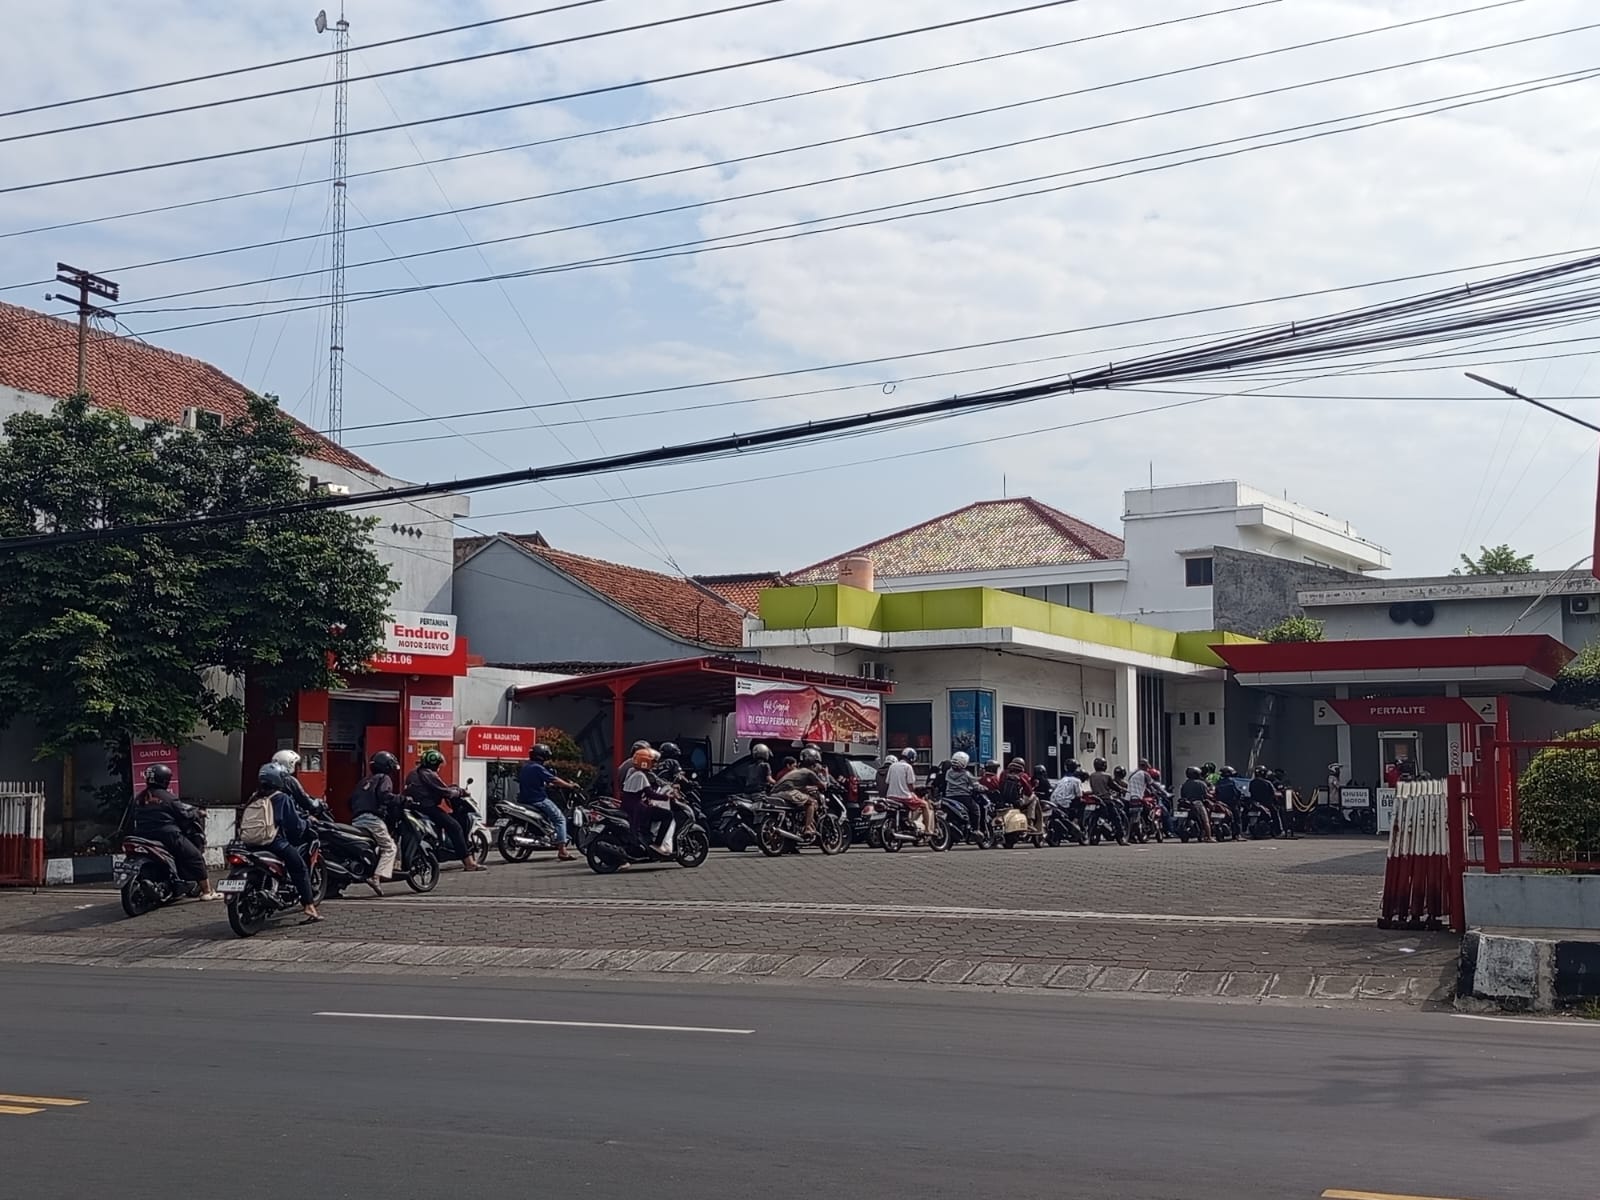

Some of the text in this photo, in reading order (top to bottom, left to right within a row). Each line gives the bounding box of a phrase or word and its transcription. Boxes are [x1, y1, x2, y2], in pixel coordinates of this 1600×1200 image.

[420, 617, 449, 627] PERTAMINA
[394, 625, 449, 640] Enduro
[398, 640, 449, 651] MOTOR SERVICE
[1317, 706, 1426, 718] 5 PERTALITE
[494, 734, 520, 742] RADIATOR
[140, 749, 171, 758] GANTI OLI
[490, 744, 509, 752] ANGIN
[509, 745, 523, 753] BAN
